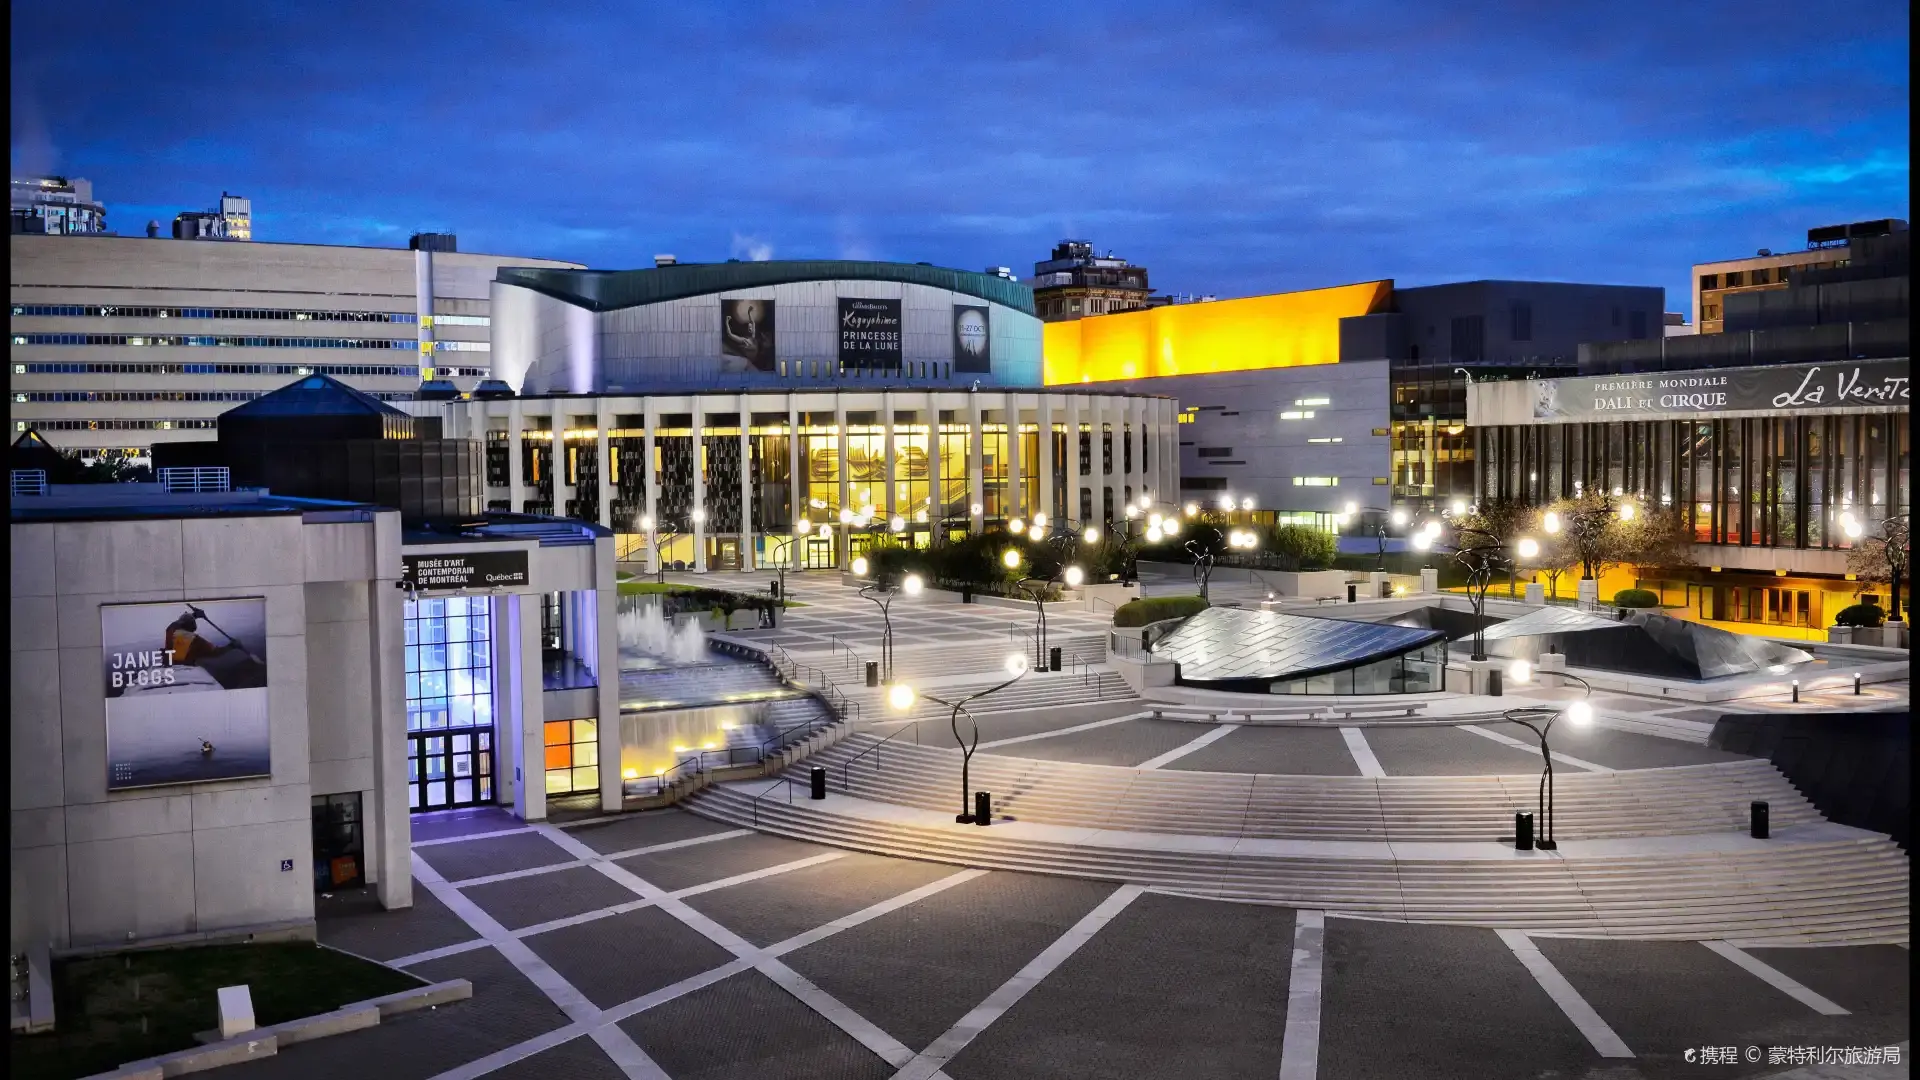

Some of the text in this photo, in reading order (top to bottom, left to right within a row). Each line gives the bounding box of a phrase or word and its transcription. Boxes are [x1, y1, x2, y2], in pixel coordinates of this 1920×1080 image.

[843, 331, 899, 341] PRINCESSE
[843, 341, 899, 350] DE LA LUNE
[1659, 376, 1728, 389] MONDIALE
[1772, 366, 1825, 408] La
[1594, 392, 1727, 410] DALI ET CIRQUE
[417, 559, 465, 569] MUSÉE D'ART
[417, 566, 475, 577] CONTEMPORAIN
[485, 572, 513, 582] Québec
[418, 574, 469, 585] DE MONTRÉAL
[112, 650, 176, 670] JANET
[112, 668, 176, 688] BIGGS
